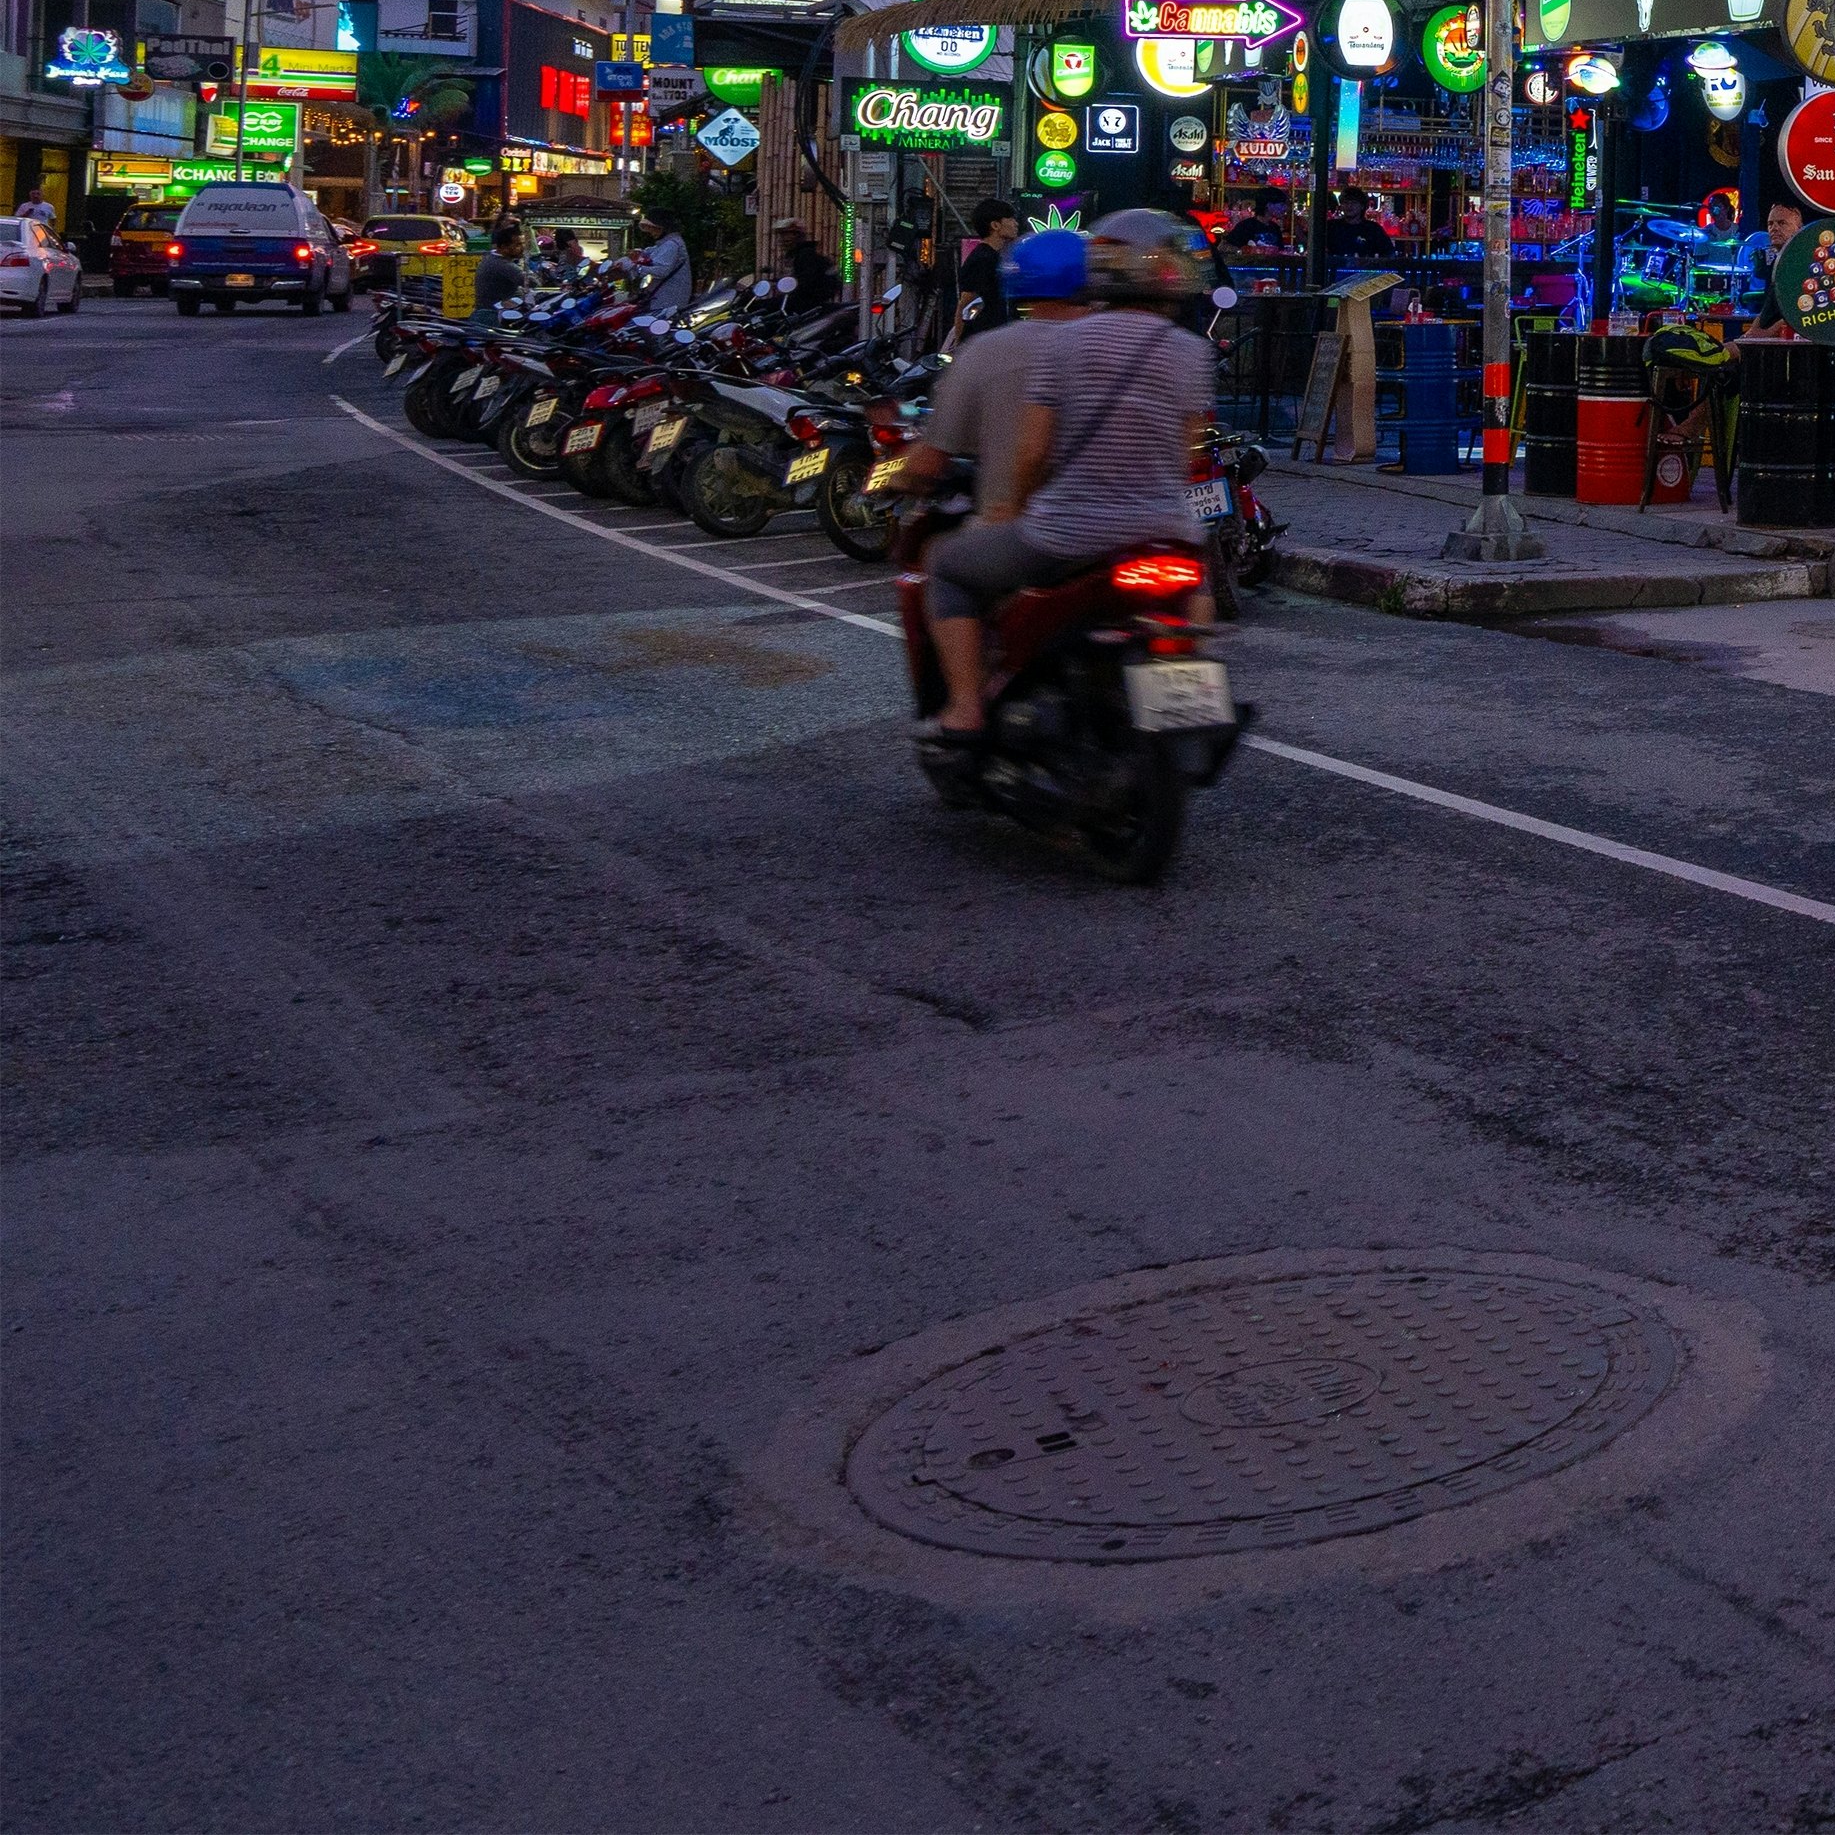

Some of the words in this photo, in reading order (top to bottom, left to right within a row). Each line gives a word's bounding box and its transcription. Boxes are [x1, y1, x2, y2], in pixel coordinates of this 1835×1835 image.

[1158, 0, 1279, 35] Cannabis
[652, 77, 695, 90] MOUNT
[857, 89, 1003, 142] Chang
[1172, 127, 1205, 141] Asahi
[1814, 136, 1833, 144] SINCE
[1239, 141, 1285, 157] KULOV
[1038, 165, 1073, 181] Chang
[1170, 163, 1204, 177] Asahi
[1570, 132, 1586, 209] Heineken
[1802, 163, 1835, 182] San
